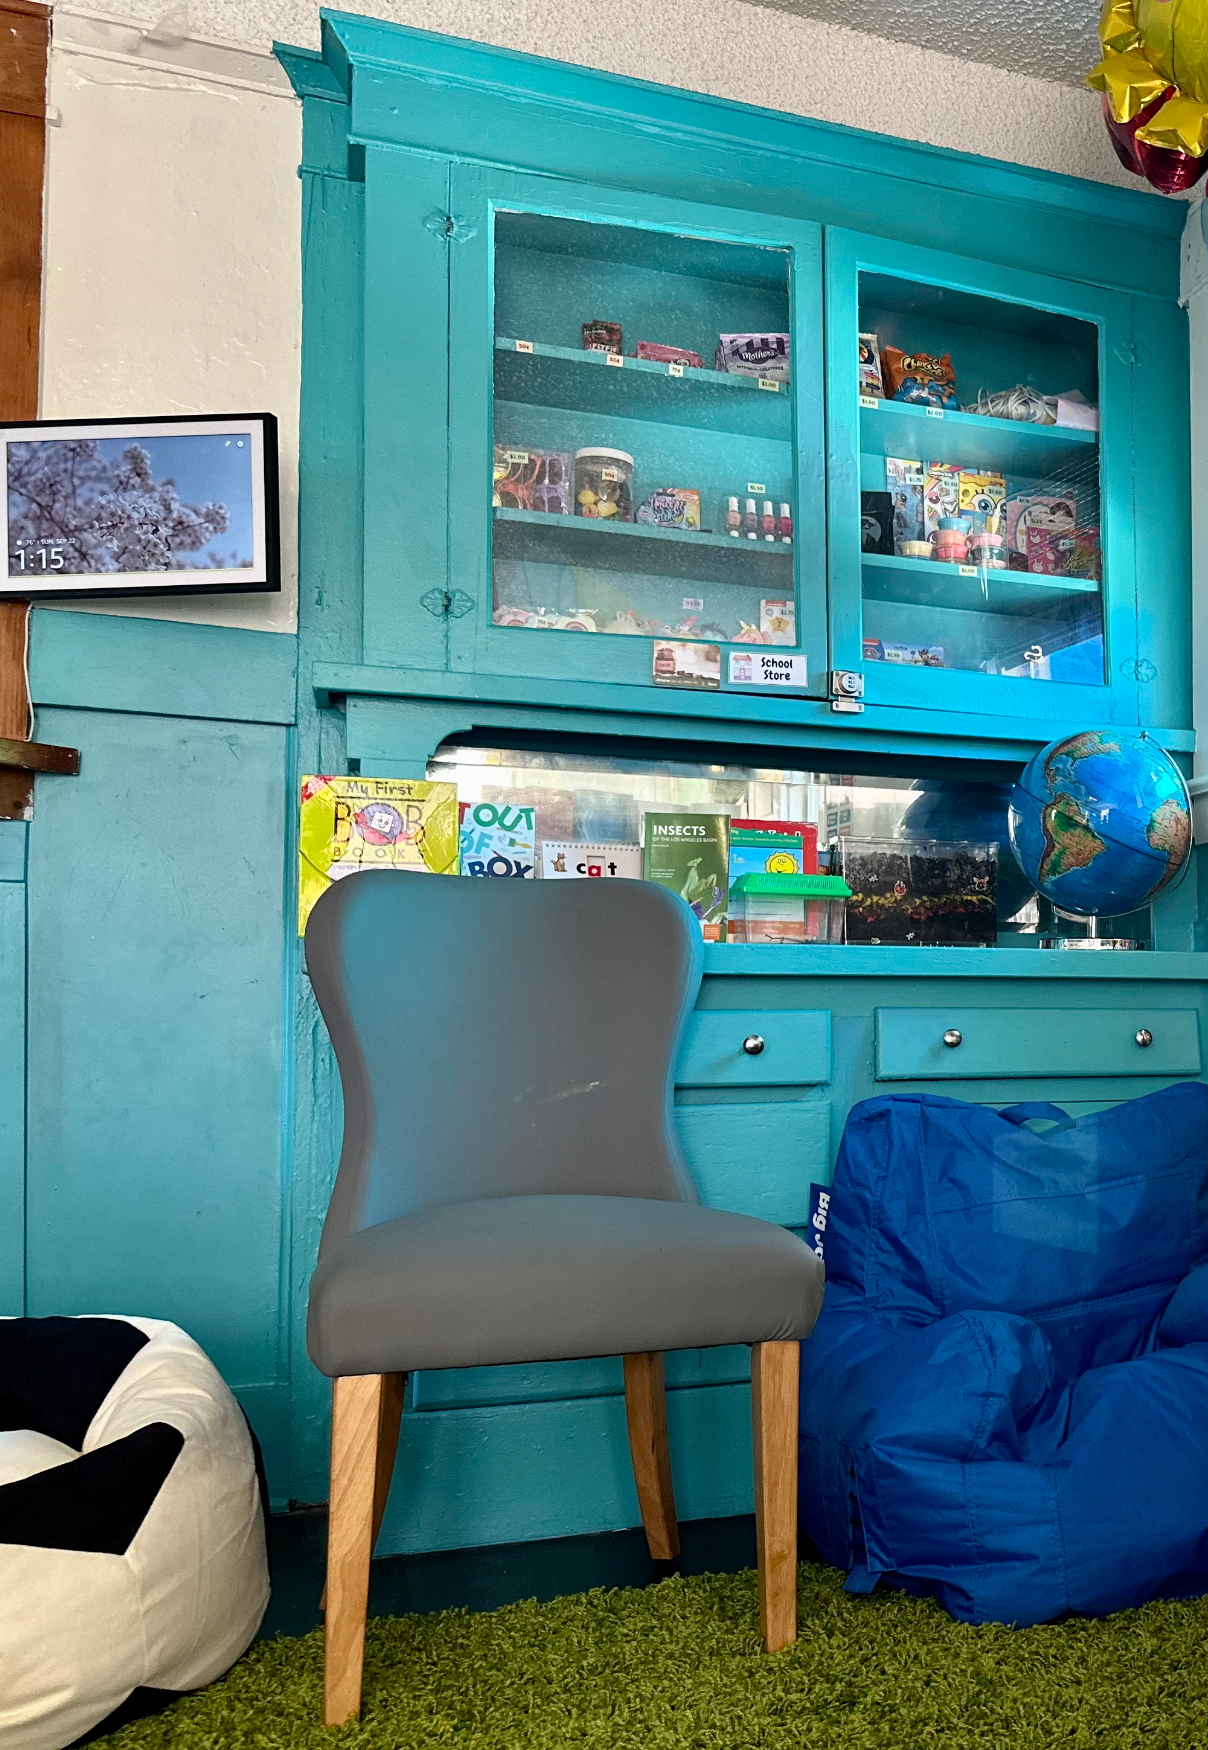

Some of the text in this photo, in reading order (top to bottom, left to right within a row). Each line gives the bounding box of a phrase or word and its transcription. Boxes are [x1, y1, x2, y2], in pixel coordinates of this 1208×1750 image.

[741, 348, 775, 361] Mother's
[15, 547, 64, 570] 1:15
[761, 657, 793, 669] School
[764, 669, 791, 681] Store
[346, 780, 414, 799] My First
[472, 804, 535, 832] OUT
[653, 825, 706, 837] INSECTS
[467, 857, 534, 878] BOX
